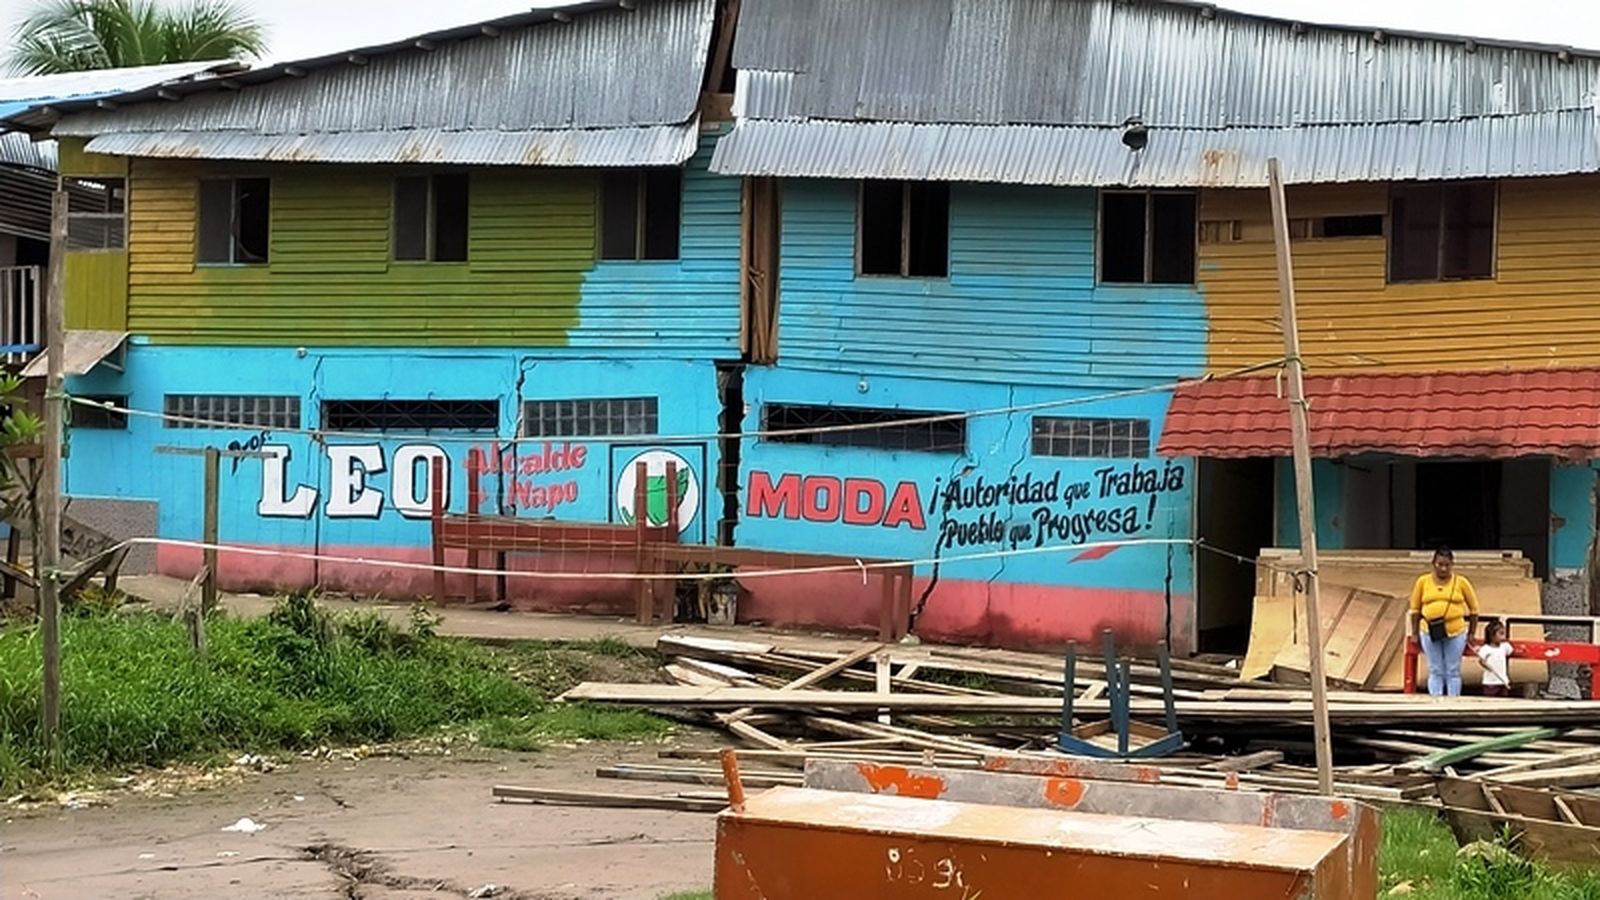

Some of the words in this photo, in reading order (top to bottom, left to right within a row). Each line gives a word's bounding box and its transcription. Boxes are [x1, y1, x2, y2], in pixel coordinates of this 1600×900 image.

[463, 440, 587, 476] Alcalde
[257, 442, 450, 520] LEO
[508, 480, 579, 513] Napo
[746, 470, 926, 530] MODA
[1064, 481, 1091, 509] que
[1094, 459, 1184, 499] Trabaja
[942, 511, 1005, 549] Pueblo
[1009, 523, 1033, 550] que
